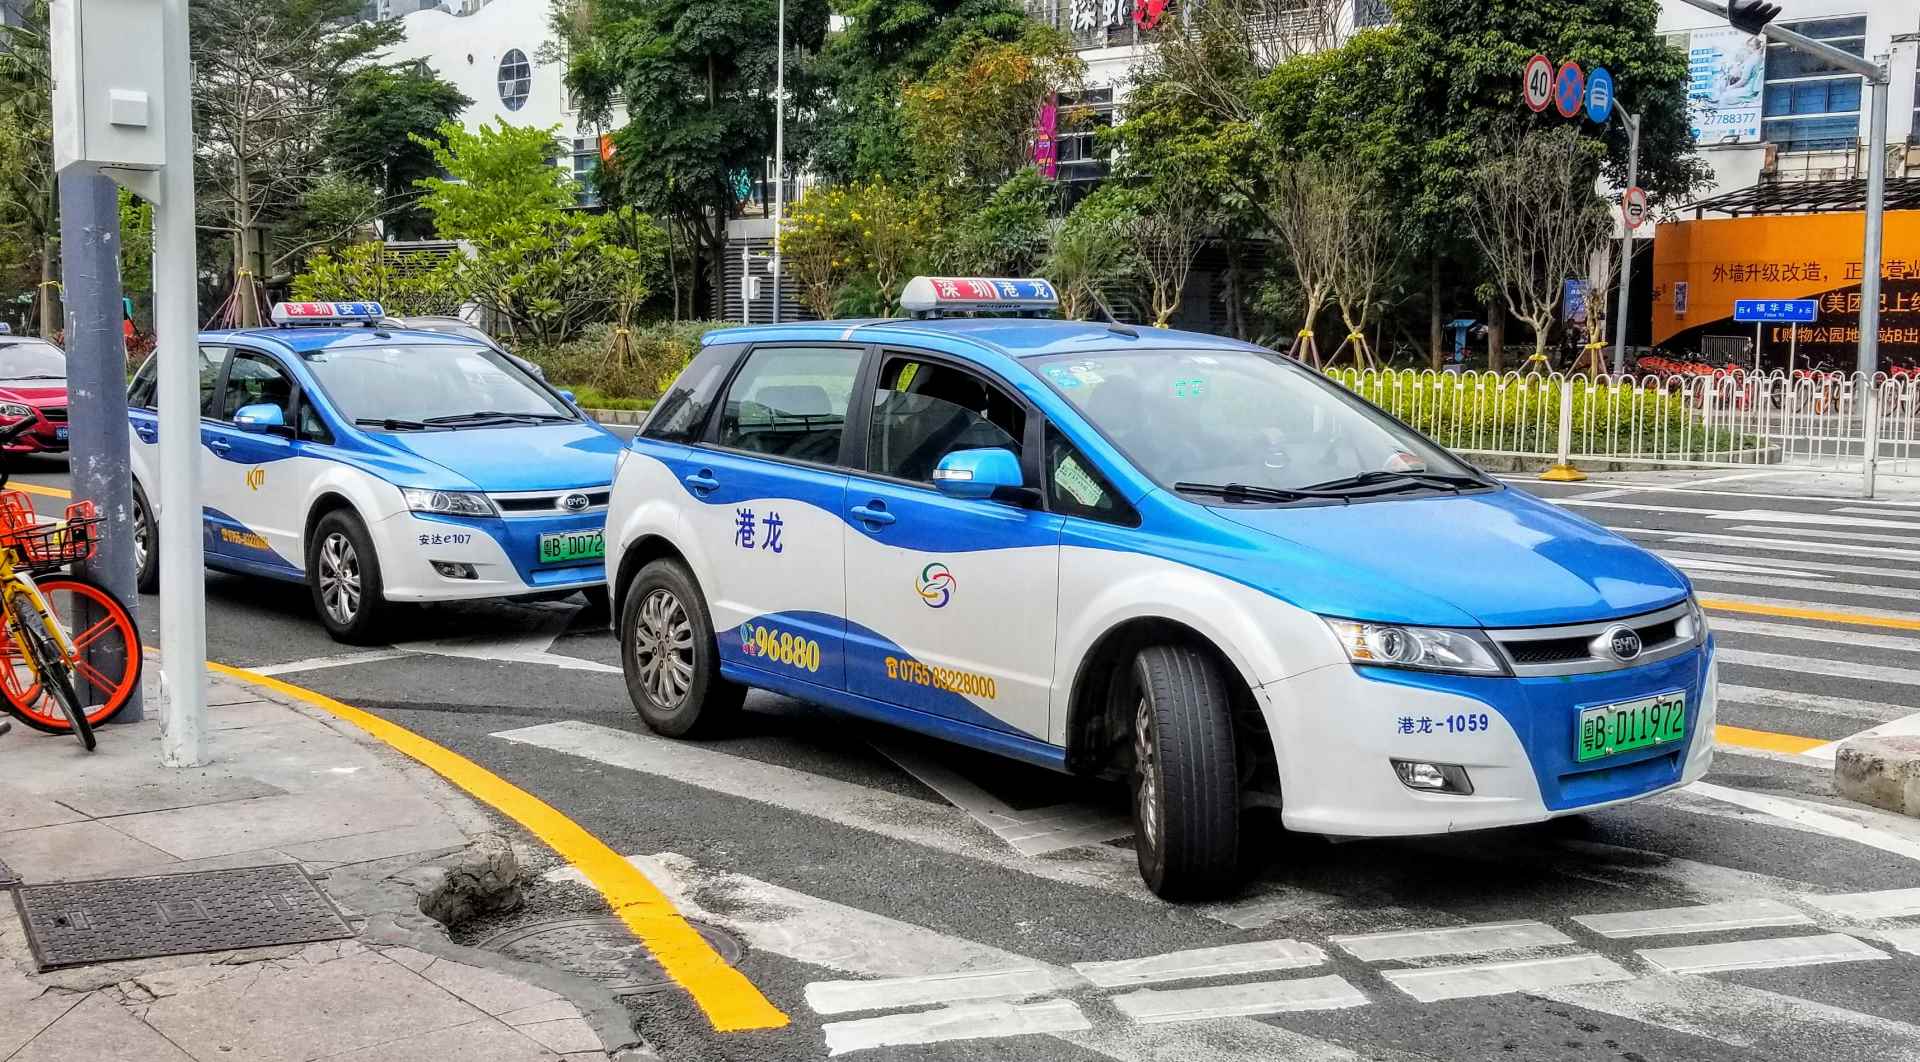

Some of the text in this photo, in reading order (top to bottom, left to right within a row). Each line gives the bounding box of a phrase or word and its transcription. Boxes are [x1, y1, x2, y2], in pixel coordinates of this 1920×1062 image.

[1530, 69, 1548, 97] 40
[1704, 113, 1756, 125] 27788377
[1772, 328, 1920, 344] 【购物公园地站B出
[567, 498, 587, 506] BYD
[735, 508, 783, 553] 港龙
[755, 626, 820, 672] 96880
[1613, 637, 1639, 650] BYD
[932, 667, 996, 699] 83228000
[1397, 714, 1489, 734] 港龙-1059
